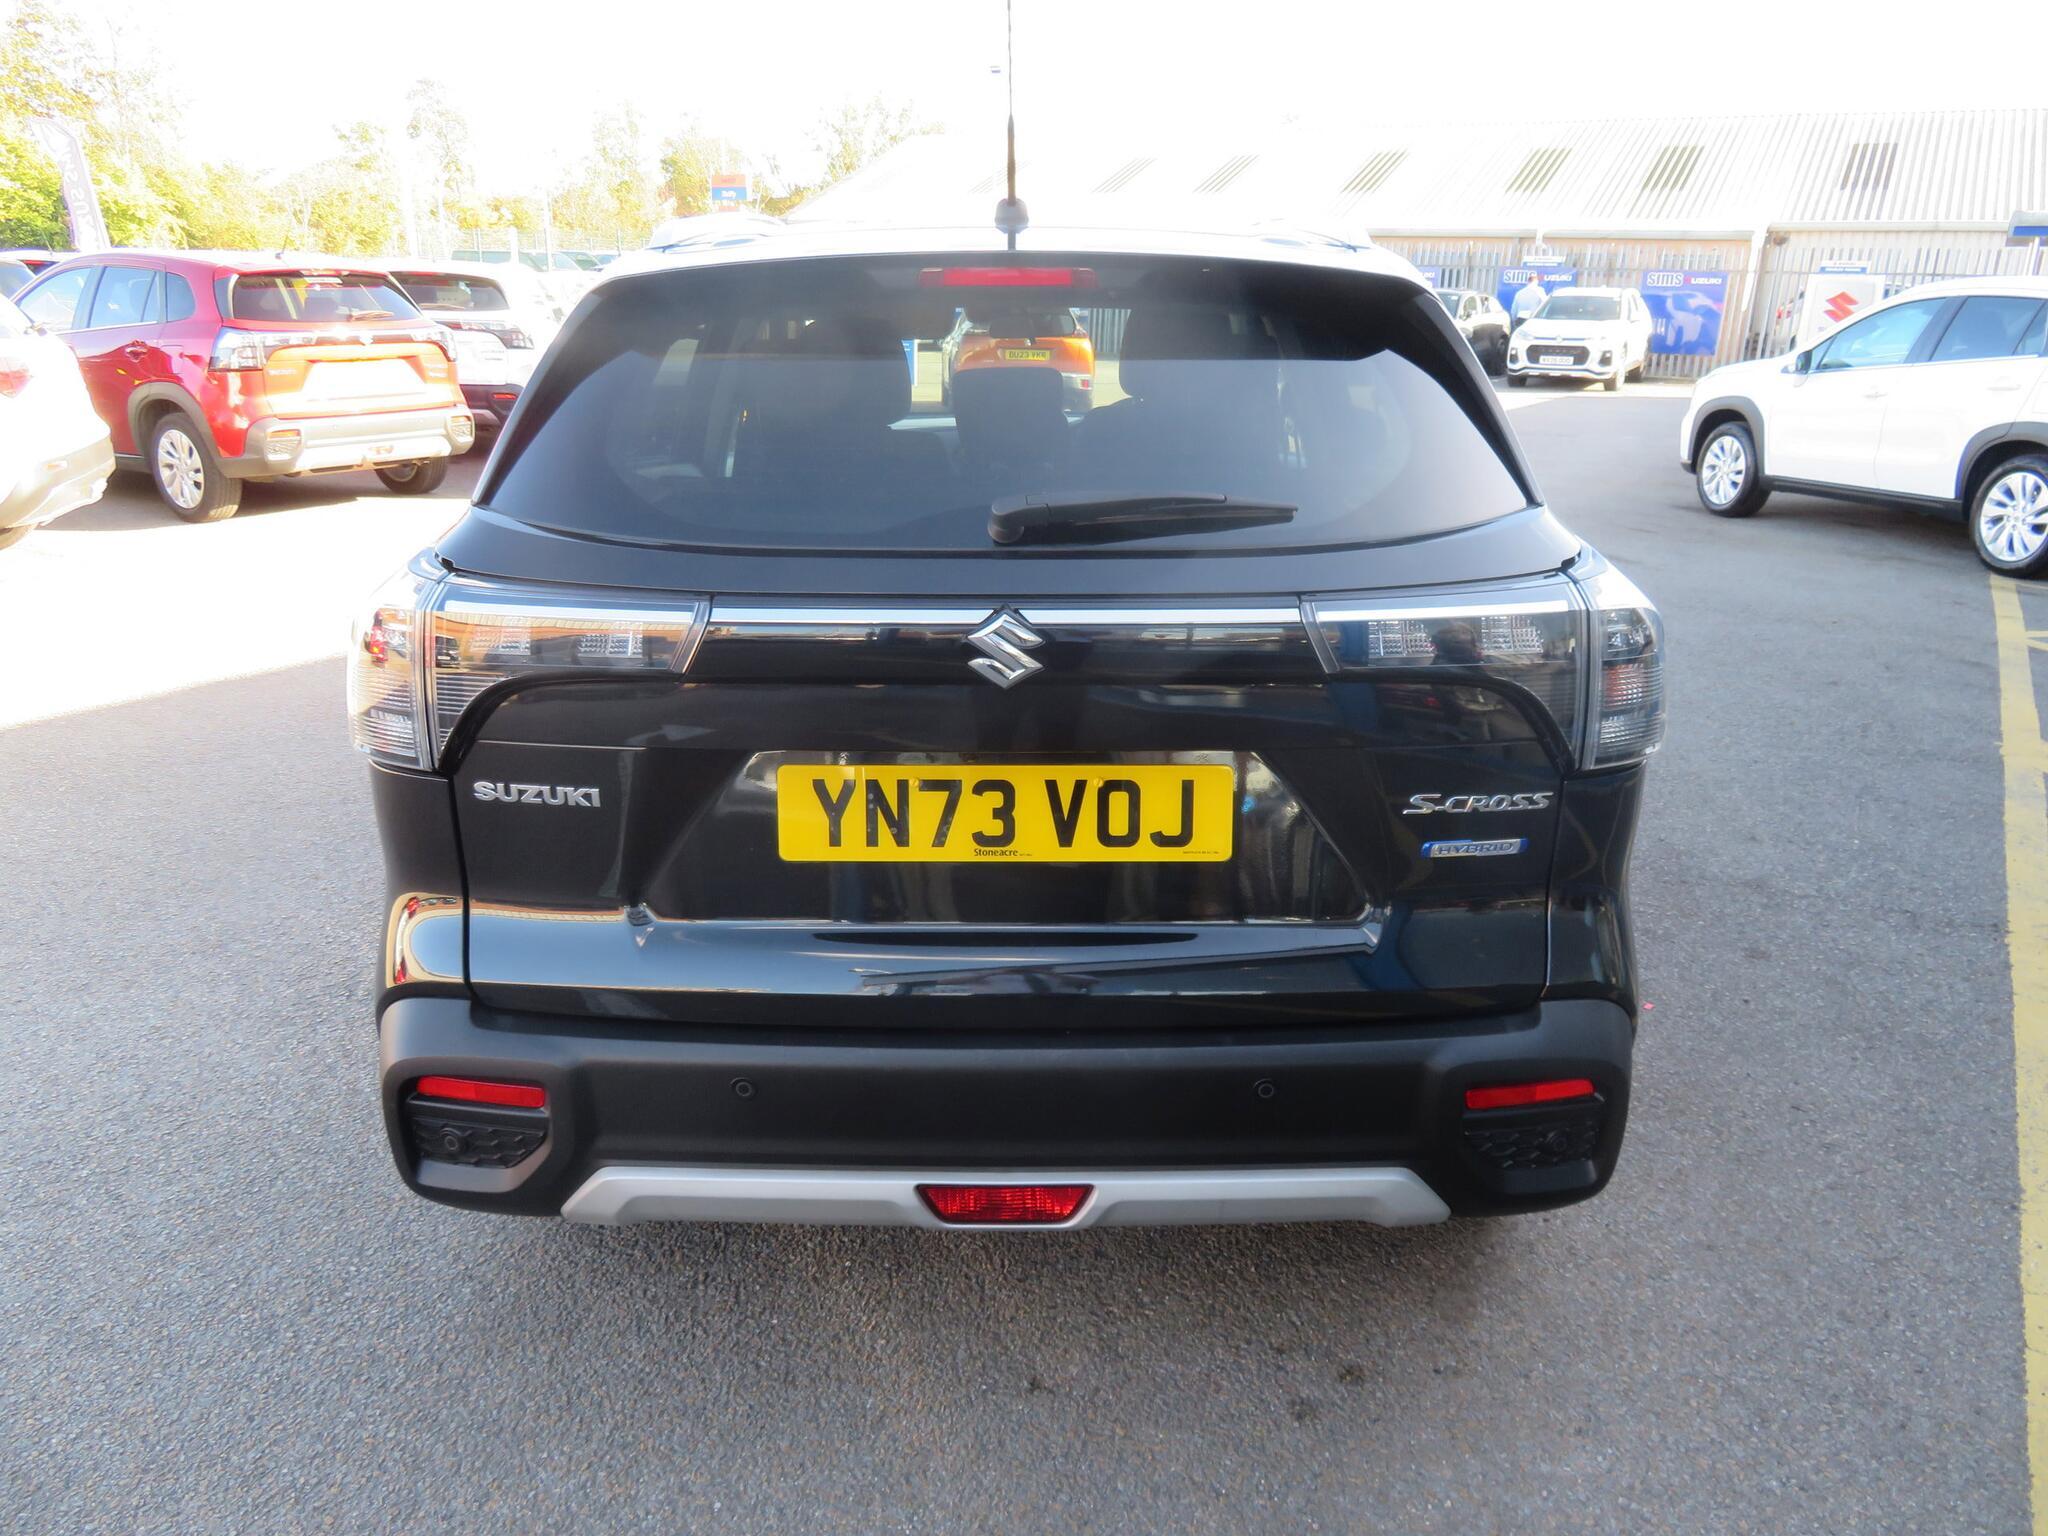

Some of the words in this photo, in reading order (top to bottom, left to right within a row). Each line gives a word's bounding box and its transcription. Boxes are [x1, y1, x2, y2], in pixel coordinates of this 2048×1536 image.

[1647, 271, 1684, 287] SIMS
[473, 781, 601, 808] SUZUKI
[1402, 791, 1554, 815] S-CROSS
[812, 778, 1016, 848] YN73
[1044, 778, 1195, 848] VOJ
[974, 848, 1018, 857] Stoneacre
[1438, 842, 1513, 855] HYBRID
